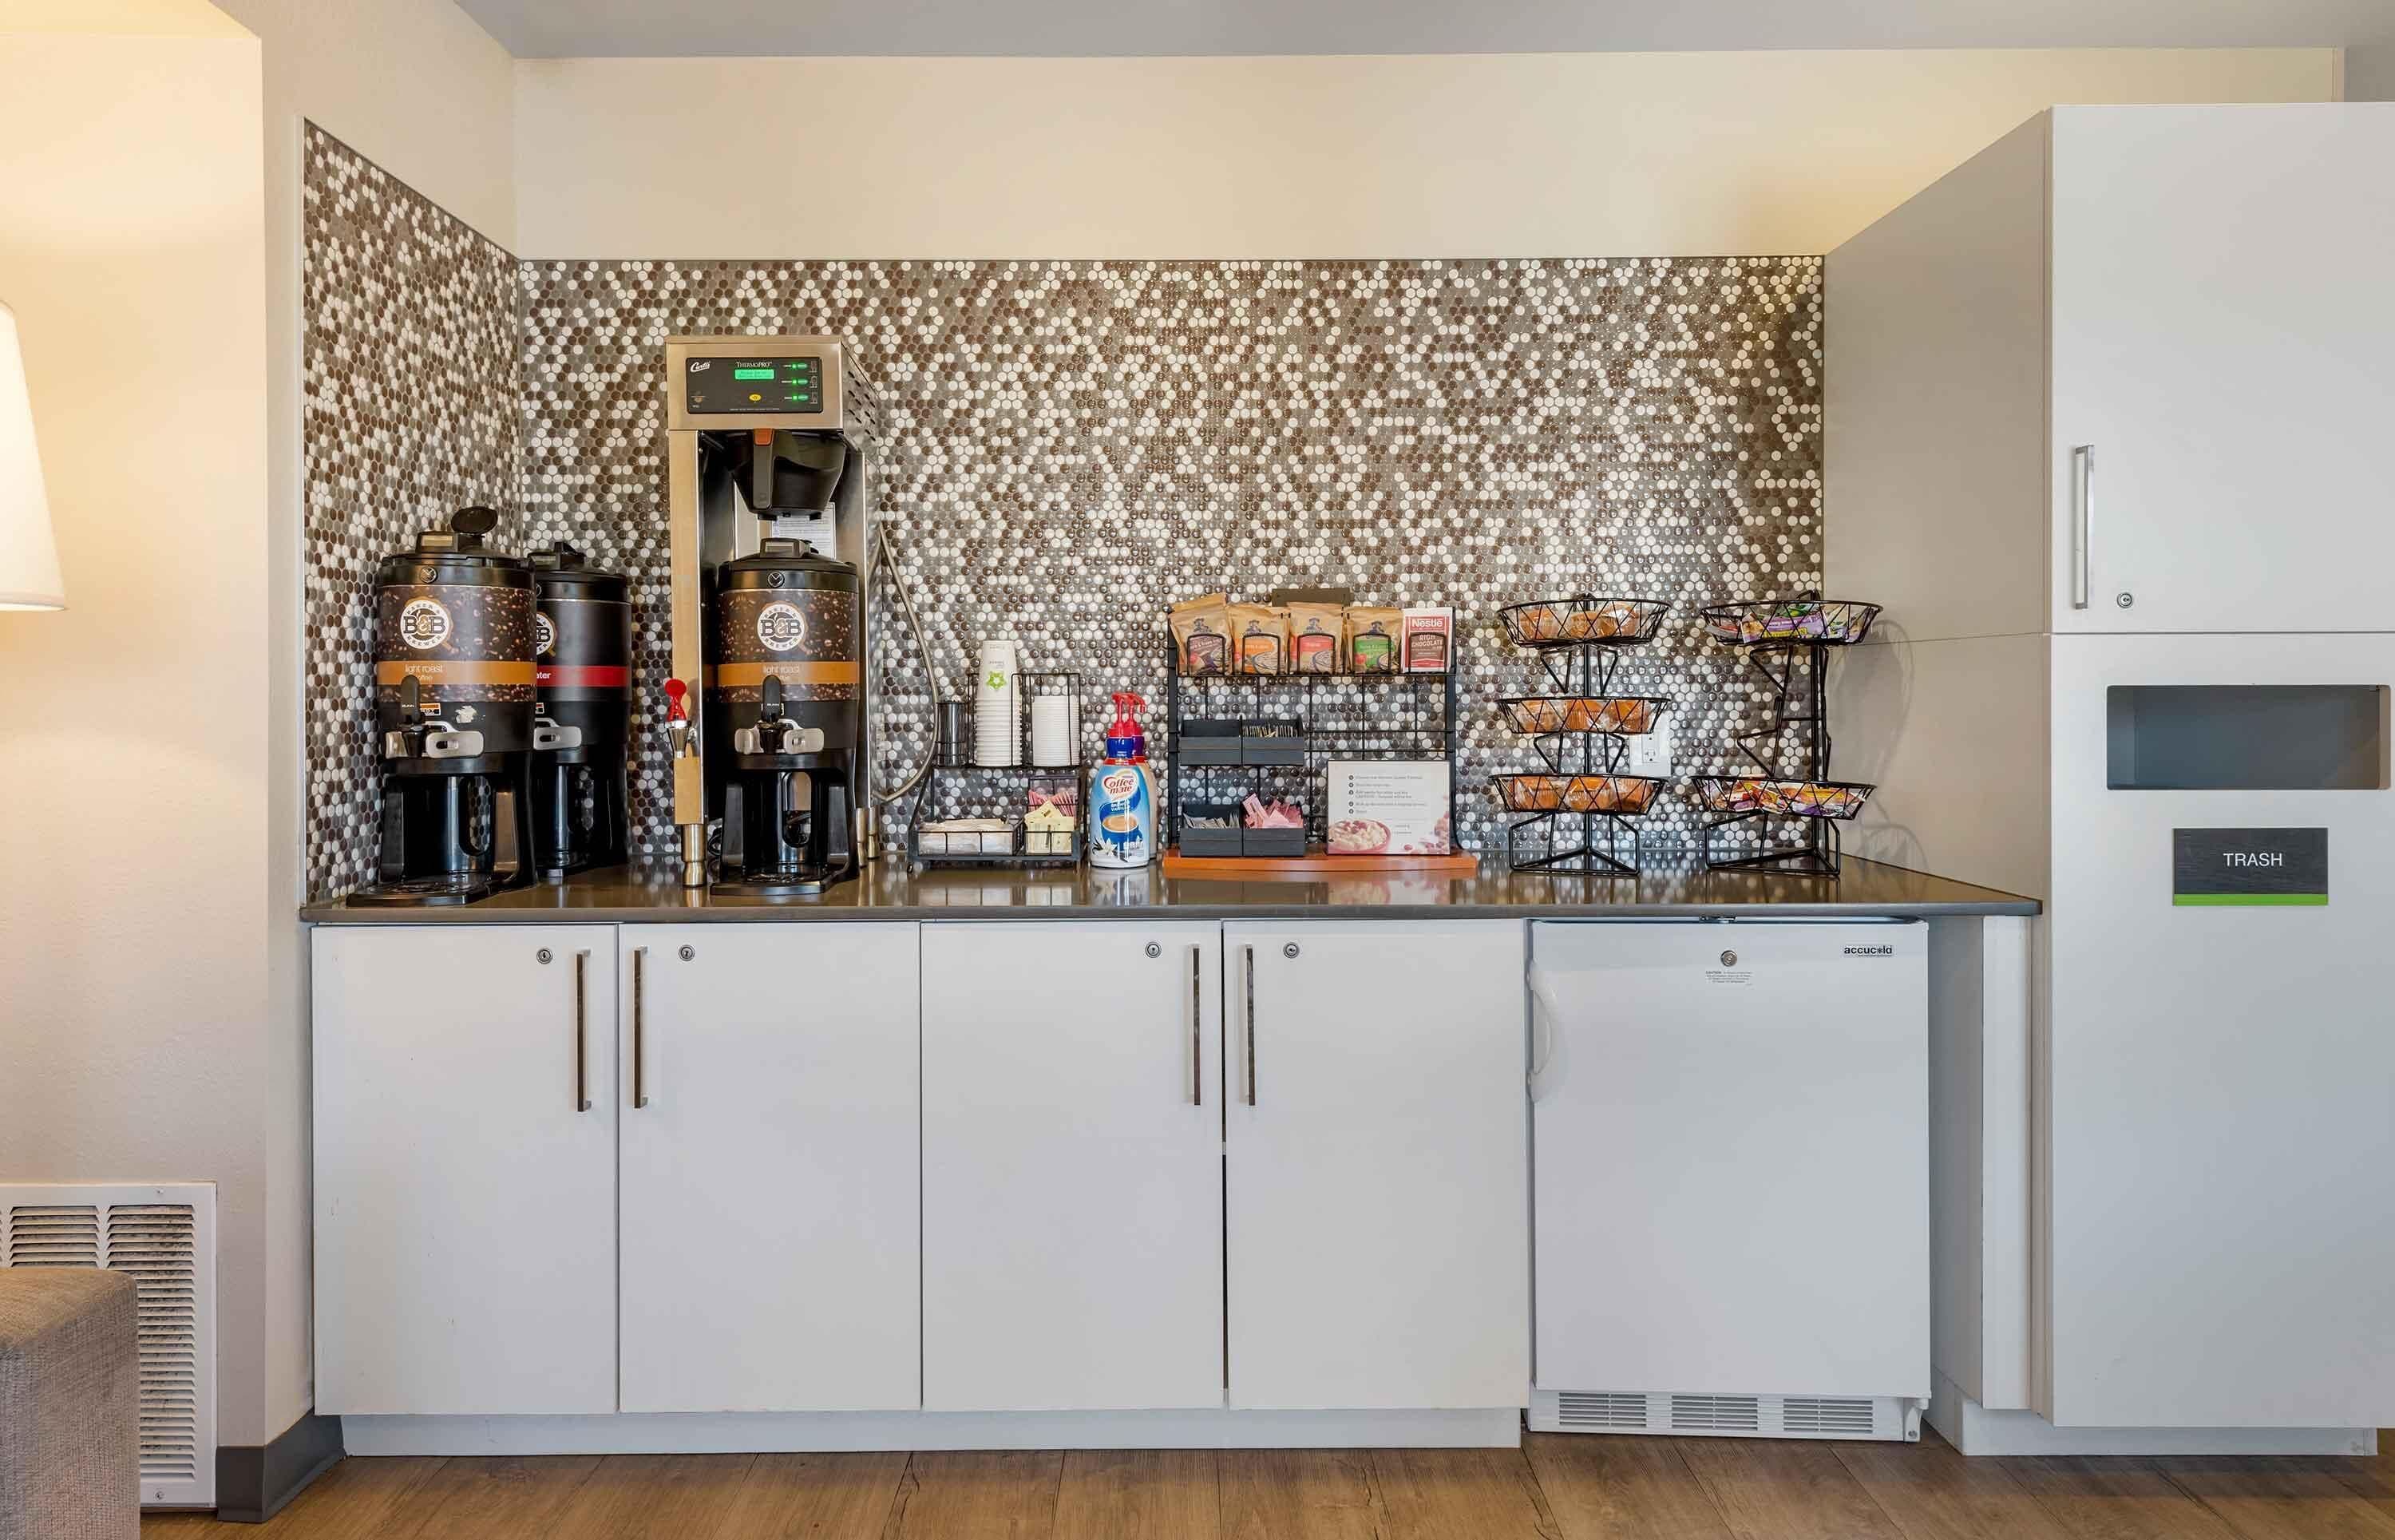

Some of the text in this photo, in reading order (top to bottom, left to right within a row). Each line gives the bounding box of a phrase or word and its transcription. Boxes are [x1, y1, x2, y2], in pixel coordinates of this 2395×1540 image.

[691, 361, 710, 372] Curtis
[403, 615, 445, 635] B&B
[761, 619, 802, 637] B&B
[405, 664, 420, 675] light
[1103, 776, 1134, 790] Coffee
[1110, 786, 1132, 794] mate
[2223, 853, 2282, 867] TRASH
